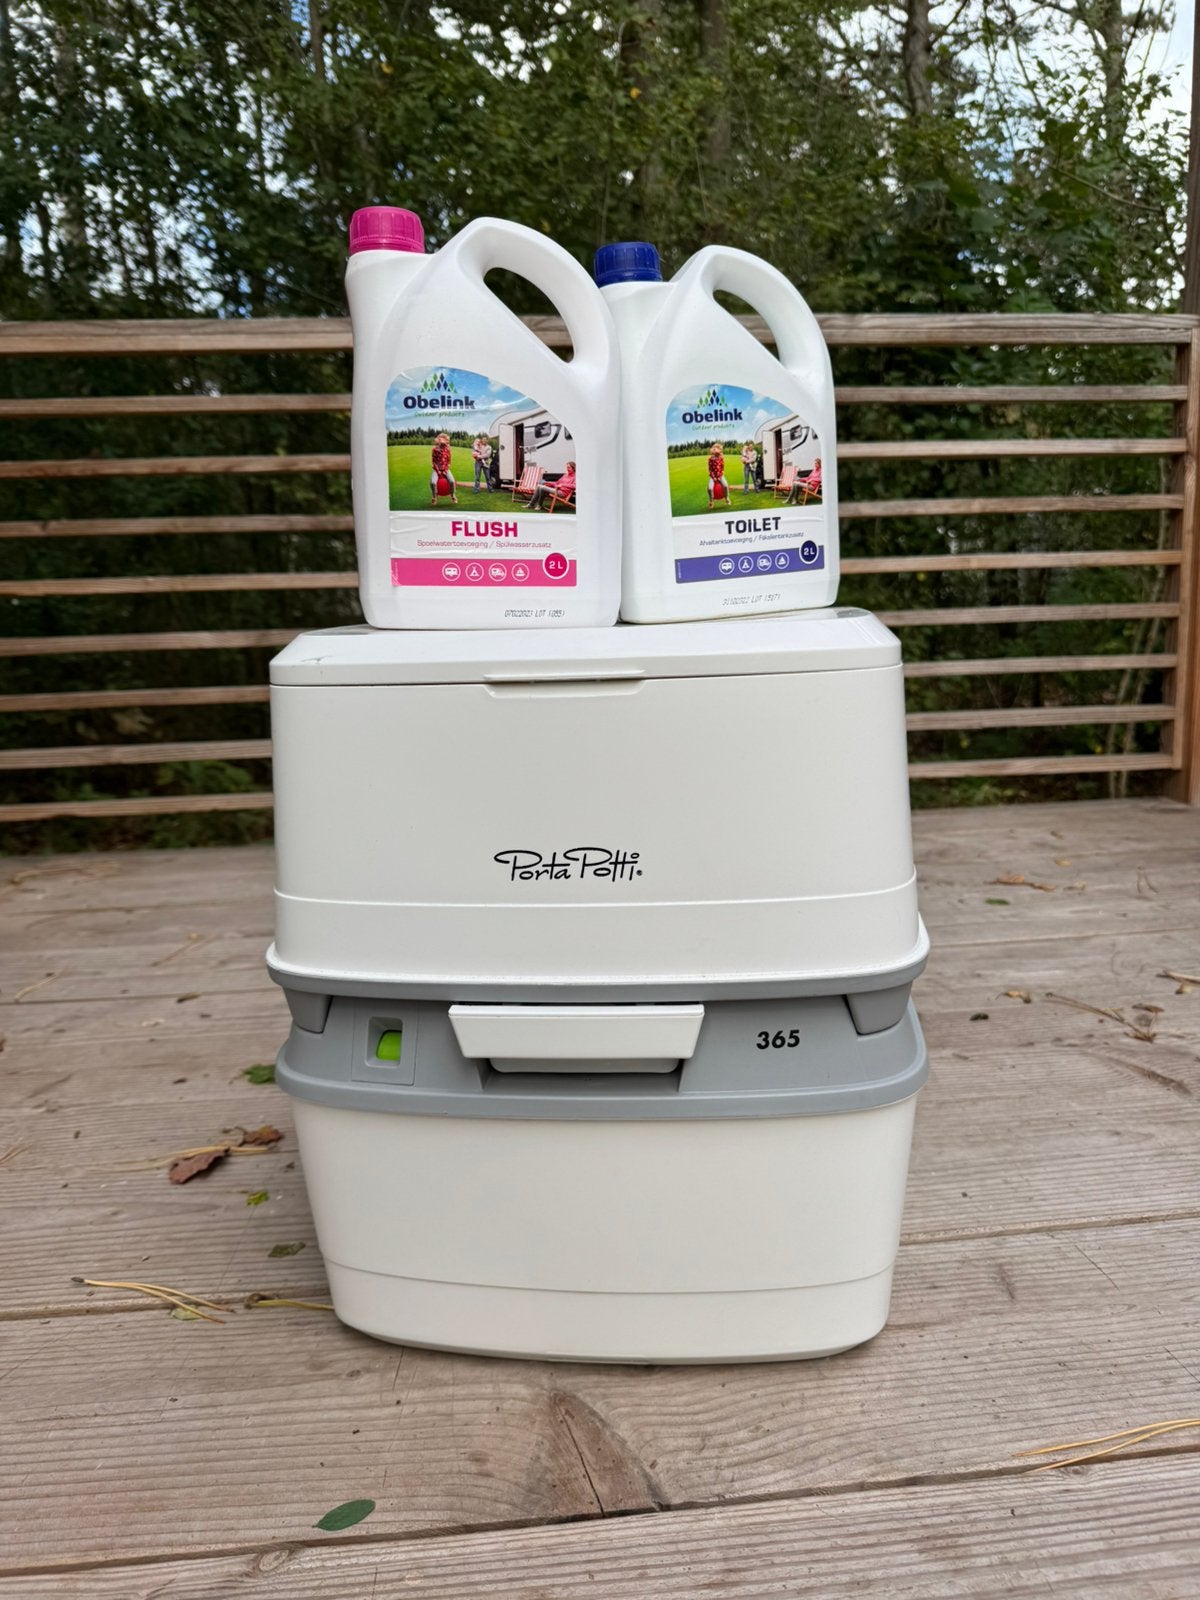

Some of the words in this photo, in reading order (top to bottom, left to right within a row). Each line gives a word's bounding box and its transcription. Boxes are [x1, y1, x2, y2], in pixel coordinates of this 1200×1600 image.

[403, 395, 476, 409] Obelink
[682, 408, 743, 424] Obelink
[451, 521, 518, 537] FLUSH
[725, 517, 781, 534] TOILET
[417, 539, 489, 549] Spoelwatertoevoeging
[803, 547, 809, 556] 2
[810, 547, 815, 555] L
[549, 560, 556, 569] 2
[557, 560, 563, 569] L
[535, 609, 546, 617] LOT
[494, 850, 571, 881] Porta
[756, 1029, 800, 1049] 365
